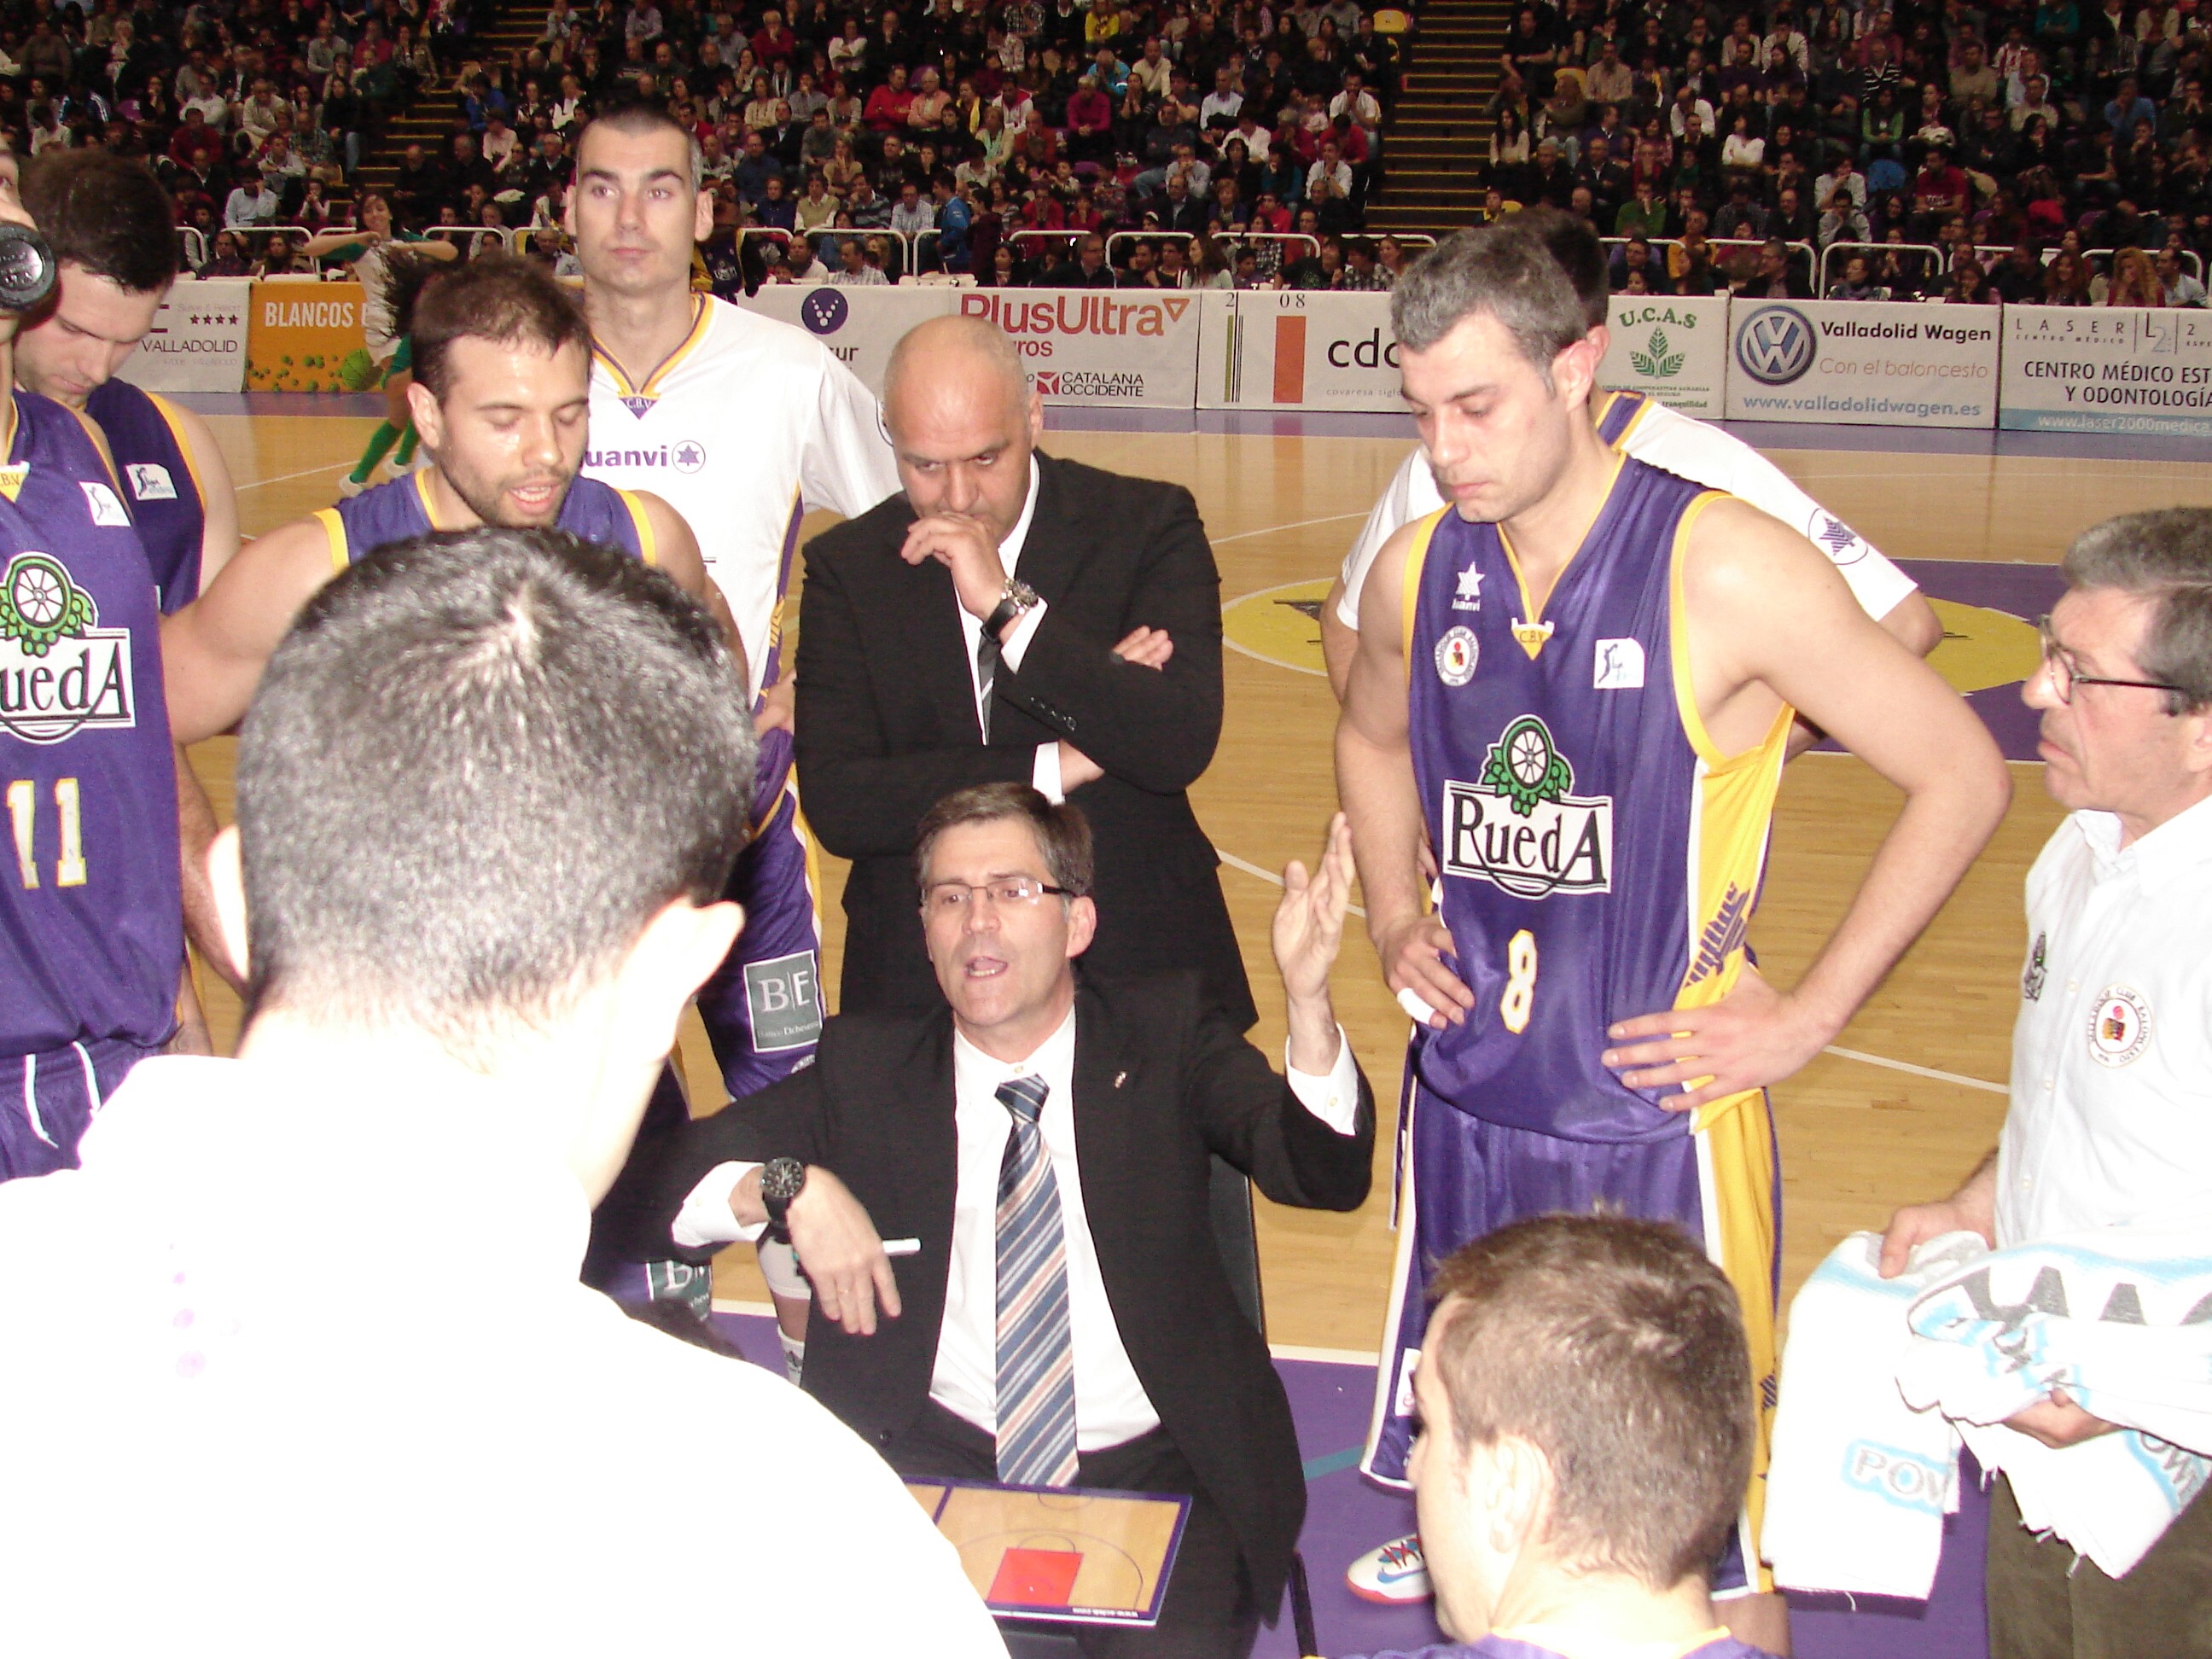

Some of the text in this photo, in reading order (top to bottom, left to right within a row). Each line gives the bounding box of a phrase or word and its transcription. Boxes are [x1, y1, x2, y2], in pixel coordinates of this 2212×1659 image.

[265, 302, 354, 328] BLANCOS
[1821, 321, 1991, 344] Valladolid Wagen
[142, 340, 238, 352] VALLADOLID
[829, 346, 859, 362] ur
[1016, 340, 1053, 357] ros
[1820, 358, 1988, 378] Con el baloncesto
[2025, 361, 2095, 379] CENTRO
[2103, 361, 2174, 382] MÉDICO
[1062, 372, 1144, 385] CATALANA
[1062, 385, 1144, 397] OCCIDENTE
[2065, 386, 2076, 402] Y
[1743, 396, 1981, 416] www.valladolidwagen.es
[585, 445, 667, 467] uanvi
[0, 642, 131, 719] uedA
[7, 778, 87, 888] 11
[1500, 928, 1537, 1034] 8
